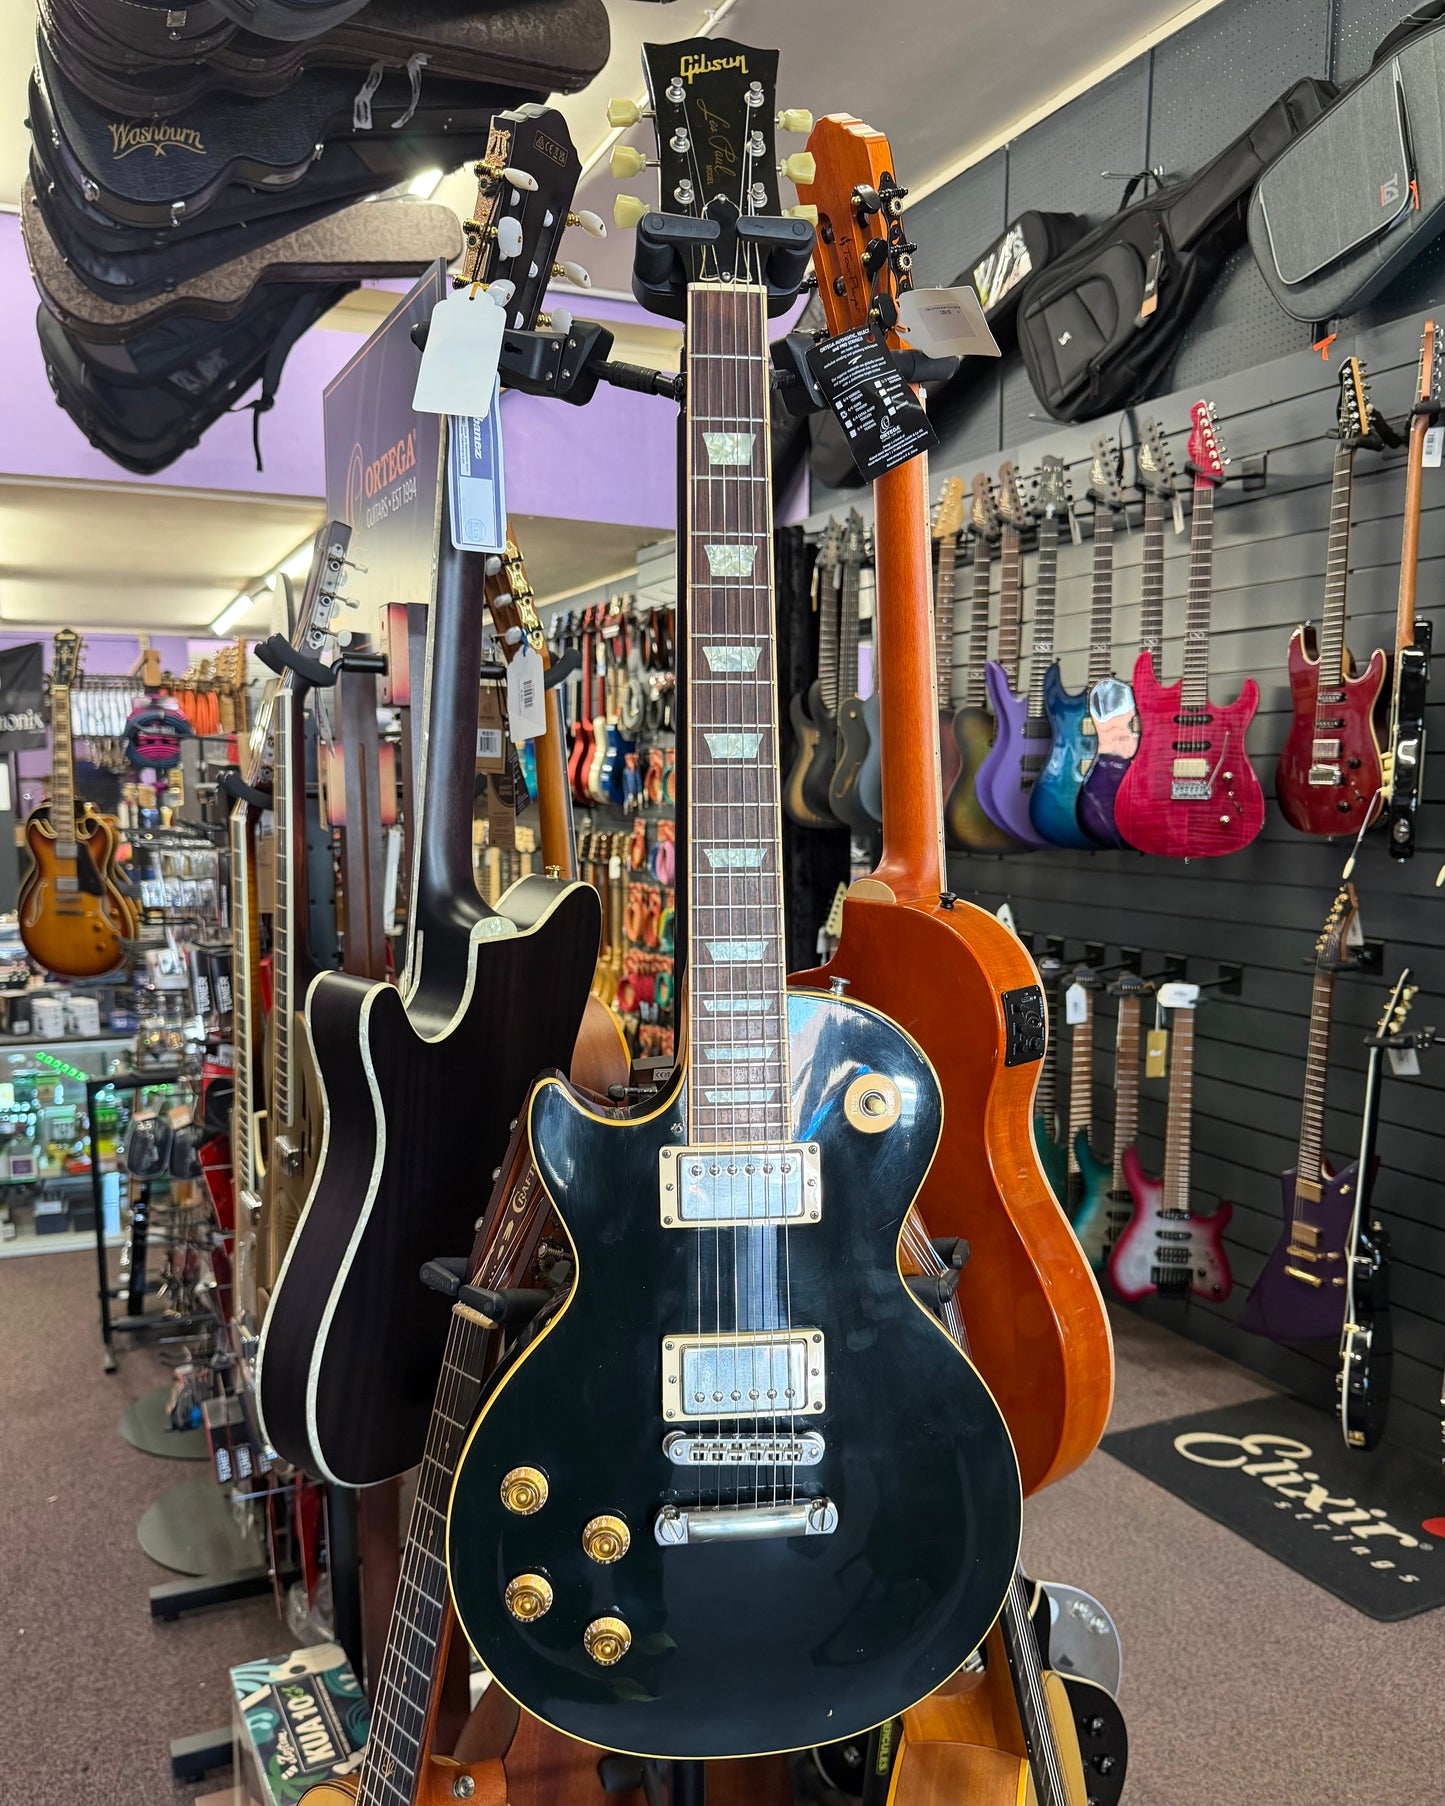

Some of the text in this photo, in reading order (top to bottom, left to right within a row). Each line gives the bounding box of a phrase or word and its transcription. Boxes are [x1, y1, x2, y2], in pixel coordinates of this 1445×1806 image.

[680, 53, 749, 84] Gibson
[107, 121, 204, 153] Washburn
[696, 98, 737, 177] Les Paul
[473, 416, 484, 459] banez
[365, 432, 416, 498] ORTEGA
[366, 476, 418, 528] GUITARS EST 1994
[199, 976, 211, 1013] TUNER
[219, 976, 233, 1013] TUNER
[1173, 1432, 1418, 1547] Elixir
[1273, 1501, 1421, 1584] strings
[879, 1720, 892, 1772] ERCULES
